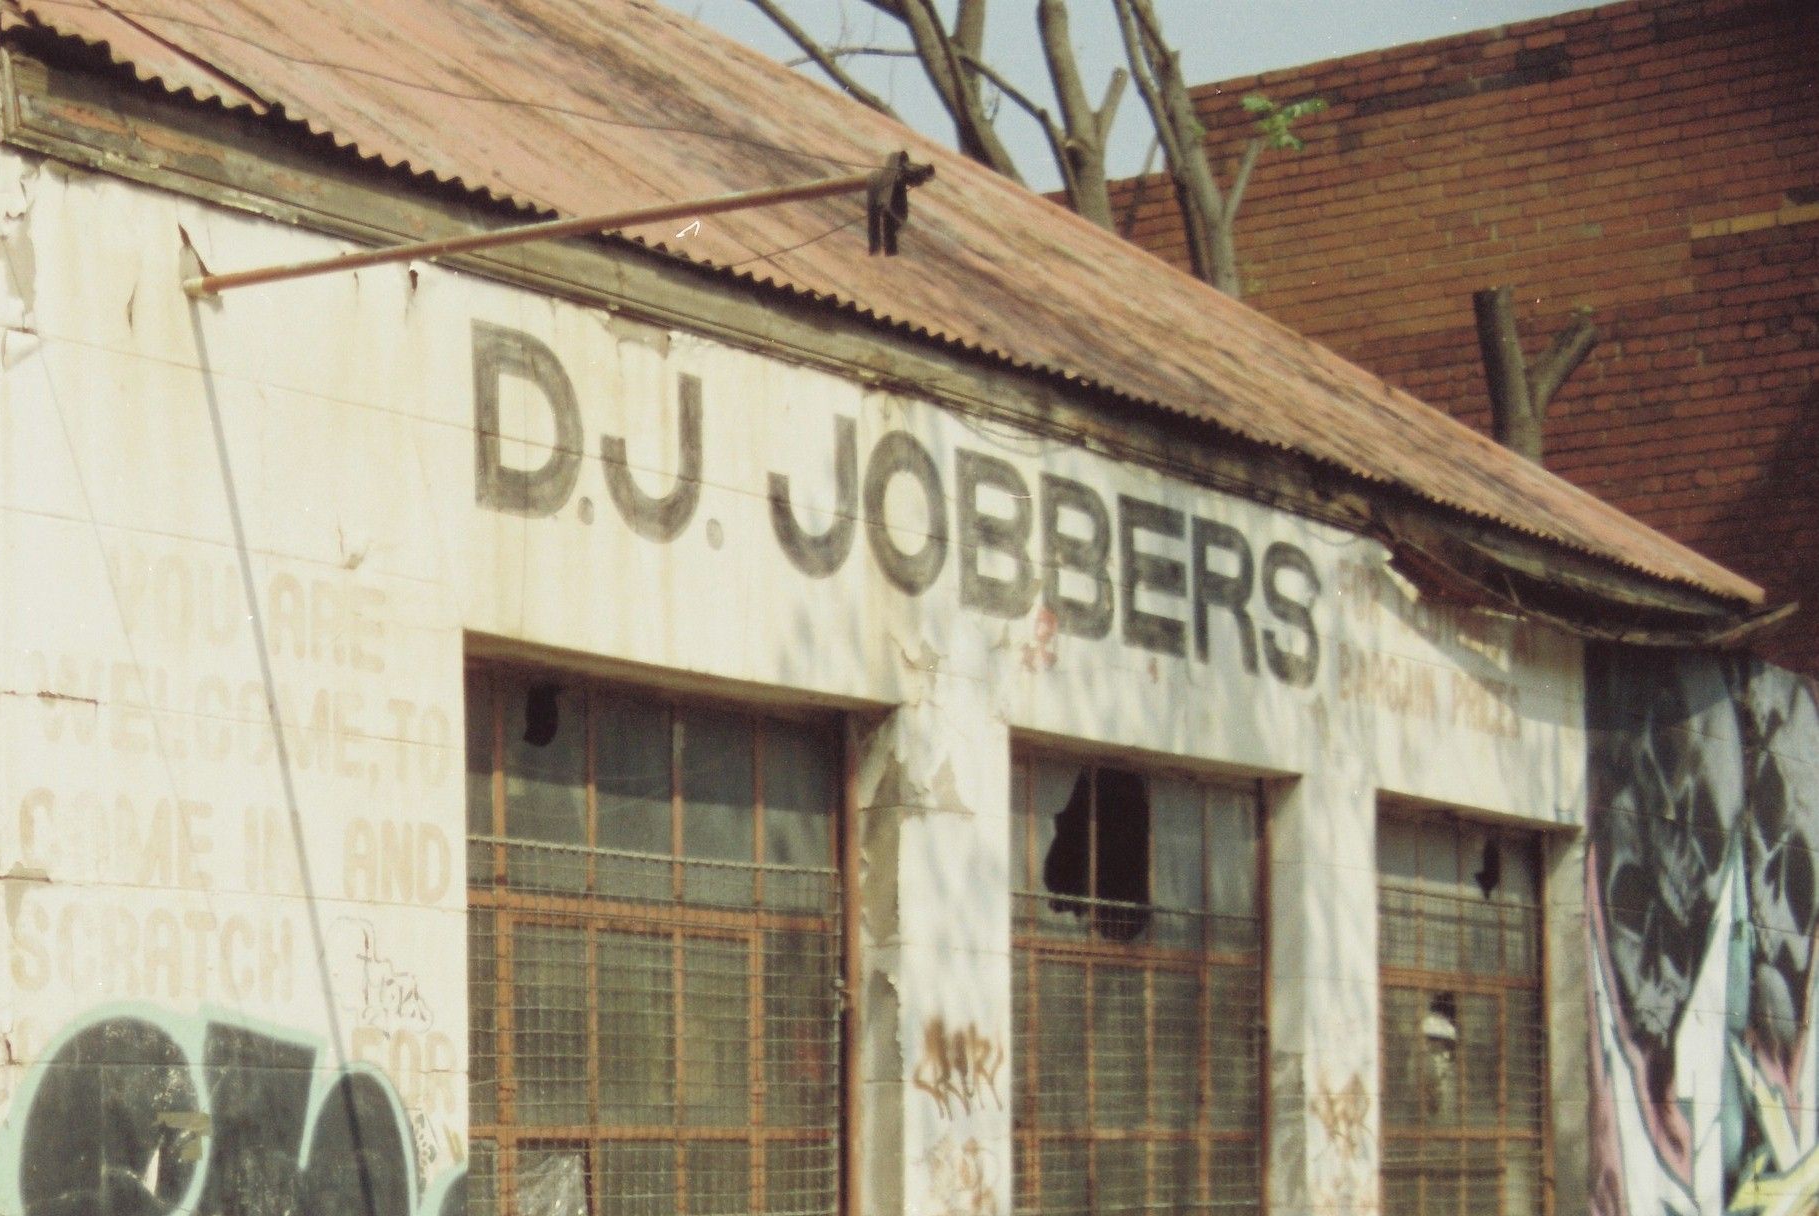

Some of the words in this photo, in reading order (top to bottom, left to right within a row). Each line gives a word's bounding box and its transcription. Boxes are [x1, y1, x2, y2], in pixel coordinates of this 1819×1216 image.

[470, 318, 725, 551] D.J.
[767, 414, 1321, 689] JOBBERS
[109, 544, 242, 648] YOU
[268, 570, 386, 674] ARE
[388, 697, 452, 790] TO
[18, 786, 213, 893] COME
[243, 797, 304, 894] IN
[342, 817, 451, 906] AND
[10, 905, 294, 1003] SCRATCH
